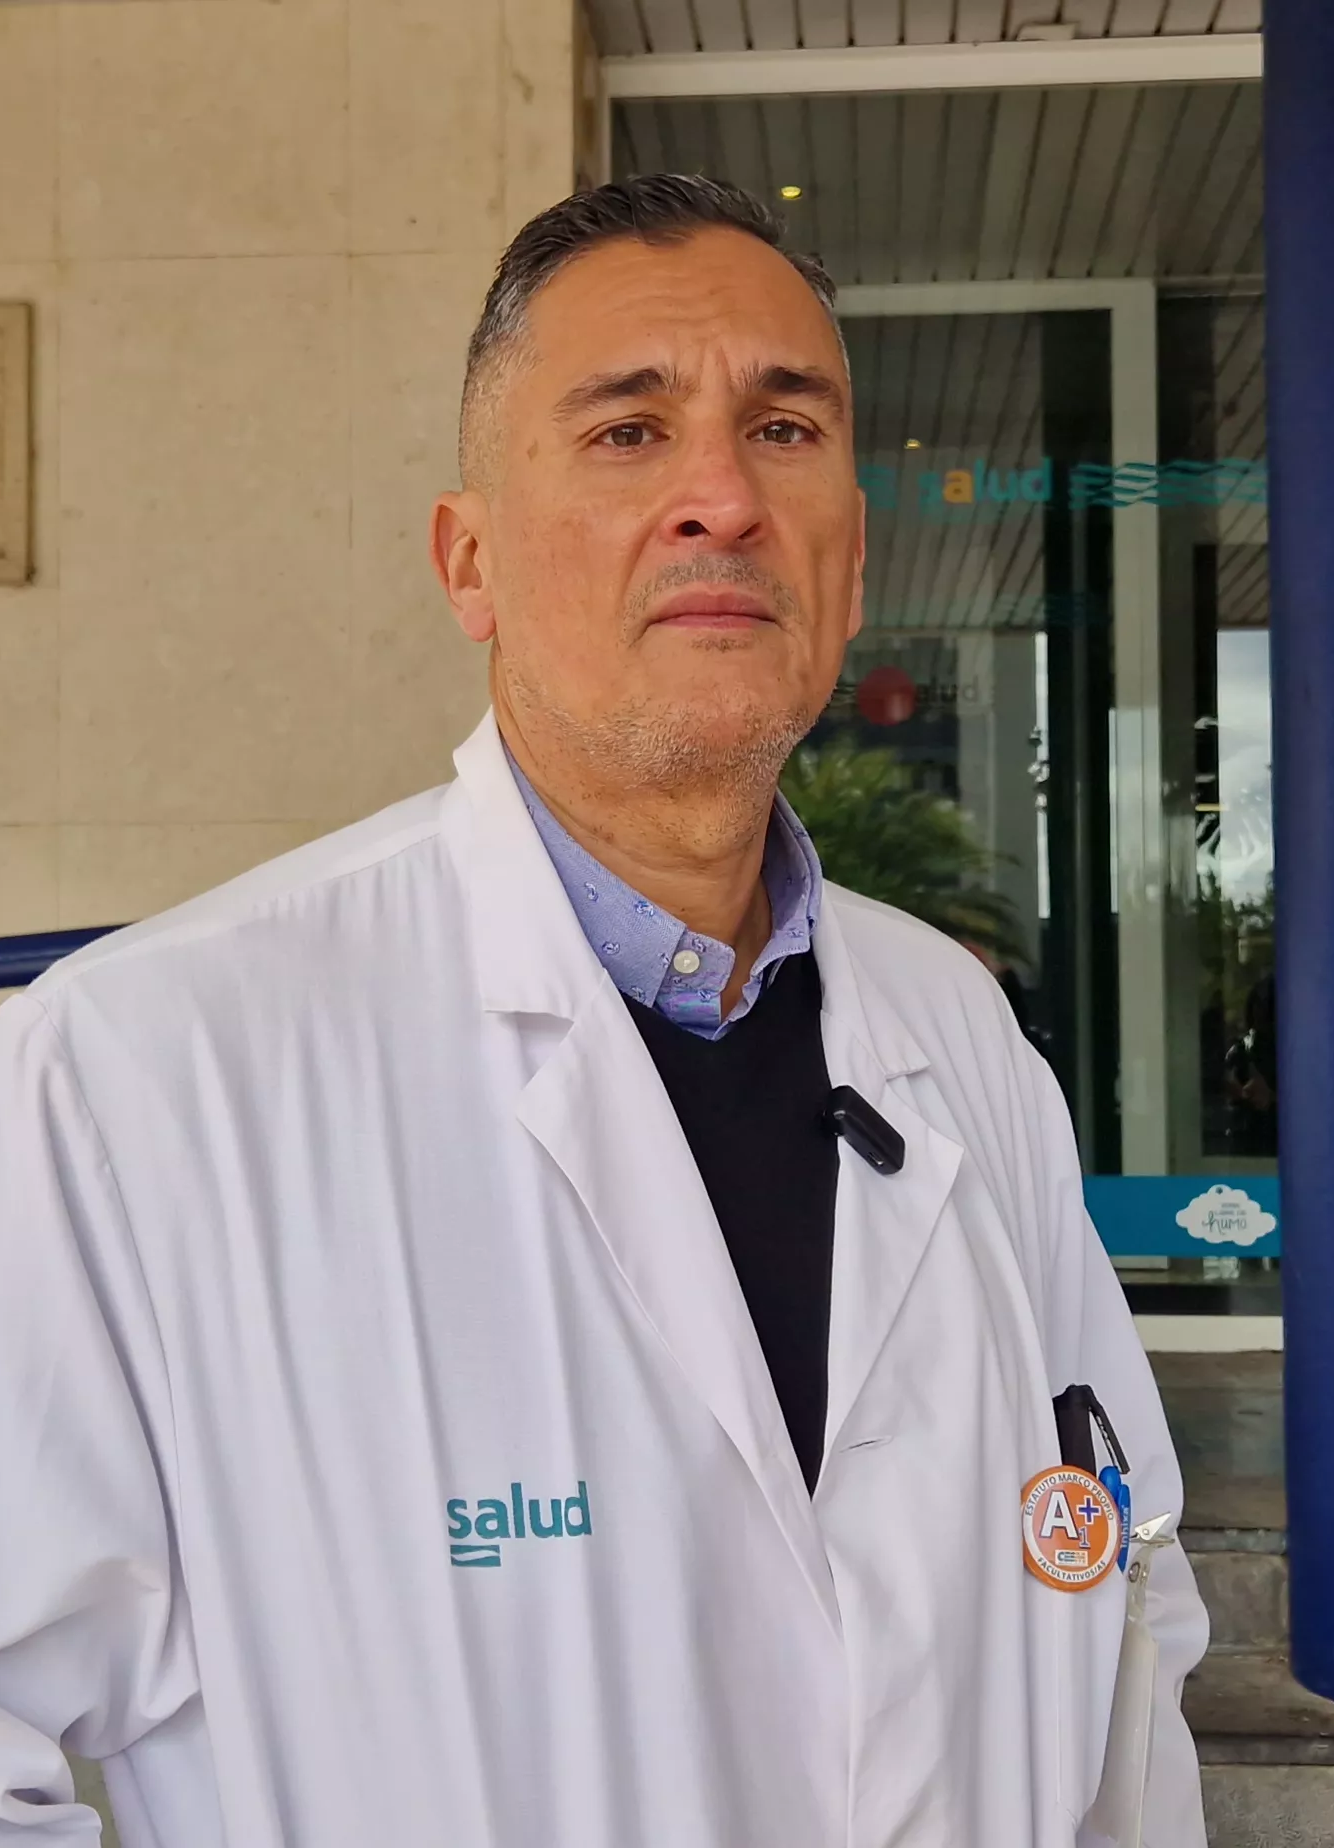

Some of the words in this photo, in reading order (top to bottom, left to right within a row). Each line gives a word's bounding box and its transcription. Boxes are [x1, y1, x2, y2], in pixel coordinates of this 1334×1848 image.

[447, 1481, 592, 1539] salud
[1024, 1474, 1057, 1516] ESTATUTO
[1058, 1473, 1091, 1488] MARCO
[1091, 1484, 1116, 1521] PROPIO
[1037, 1557, 1107, 1582] FACULTATIVOS/AS
